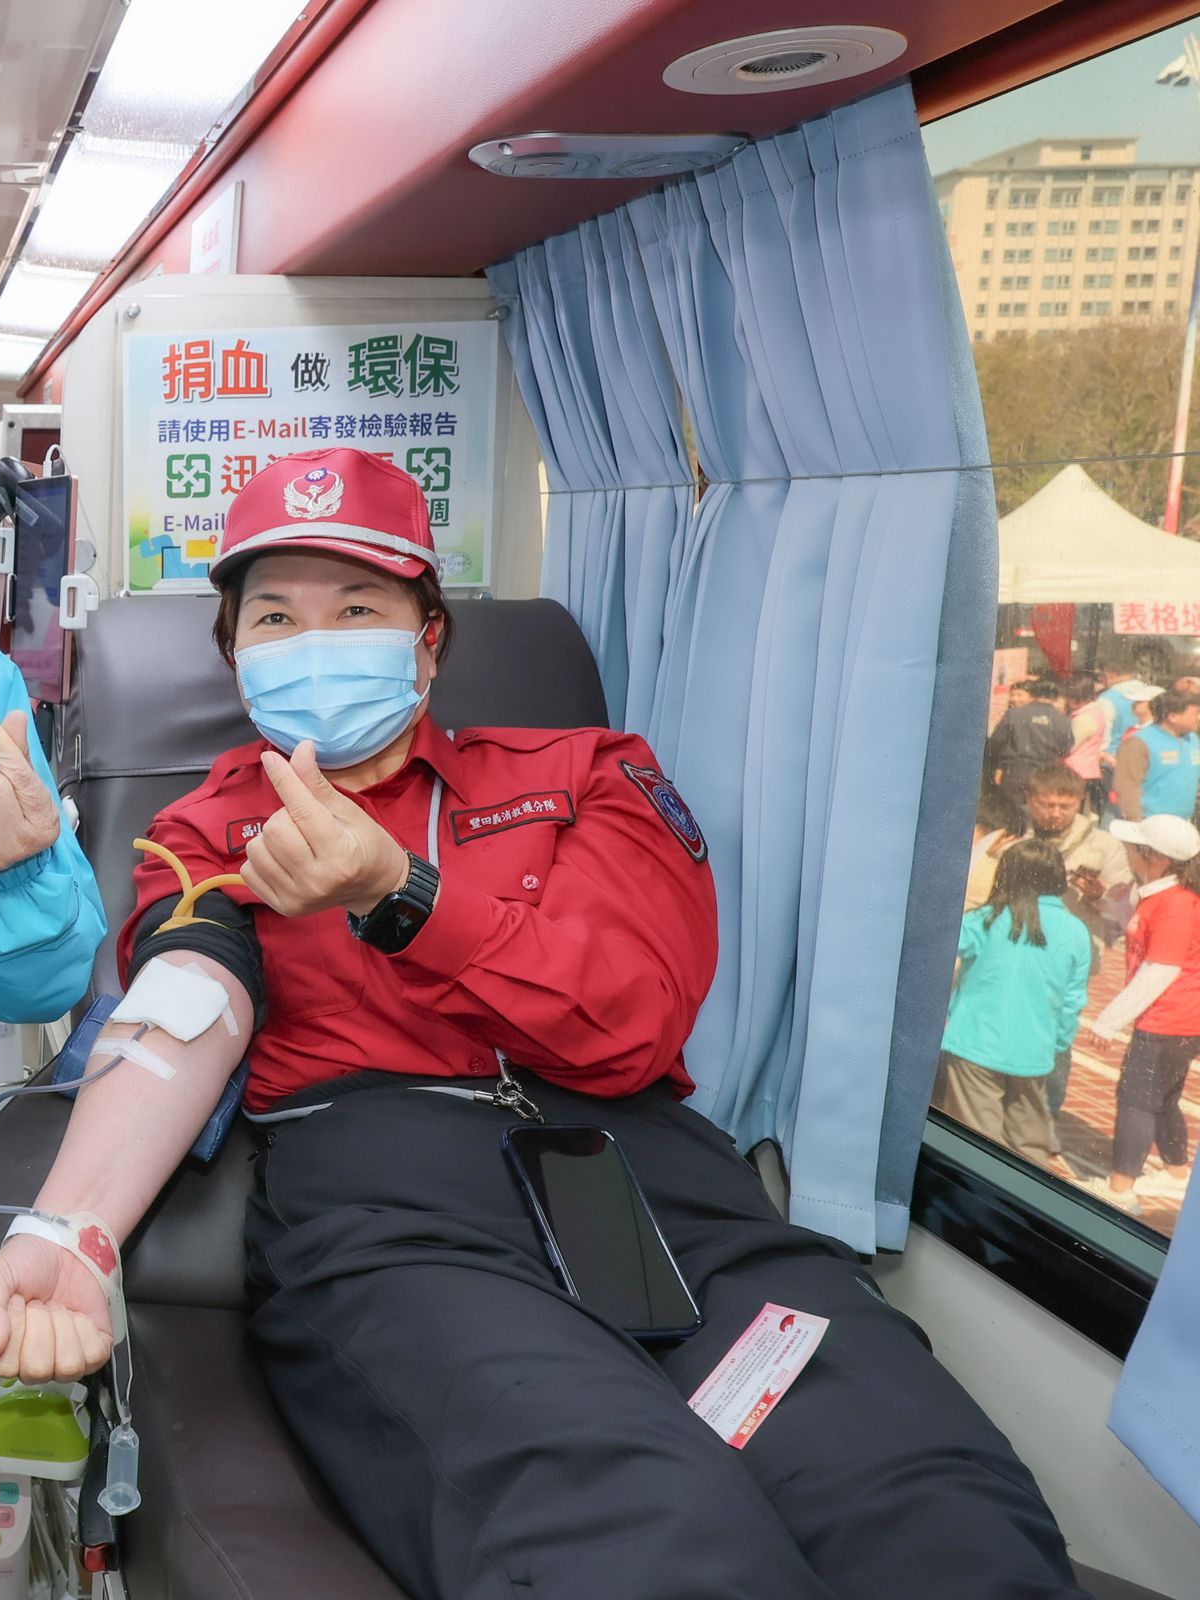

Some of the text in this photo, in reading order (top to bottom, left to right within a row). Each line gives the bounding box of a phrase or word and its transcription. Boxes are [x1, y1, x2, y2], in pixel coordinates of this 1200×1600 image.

[162, 333, 460, 402] 捐血 做 環保
[158, 412, 458, 444] 請使用E-Mail寄發檢驗報告
[164, 513, 225, 532] E-Mail
